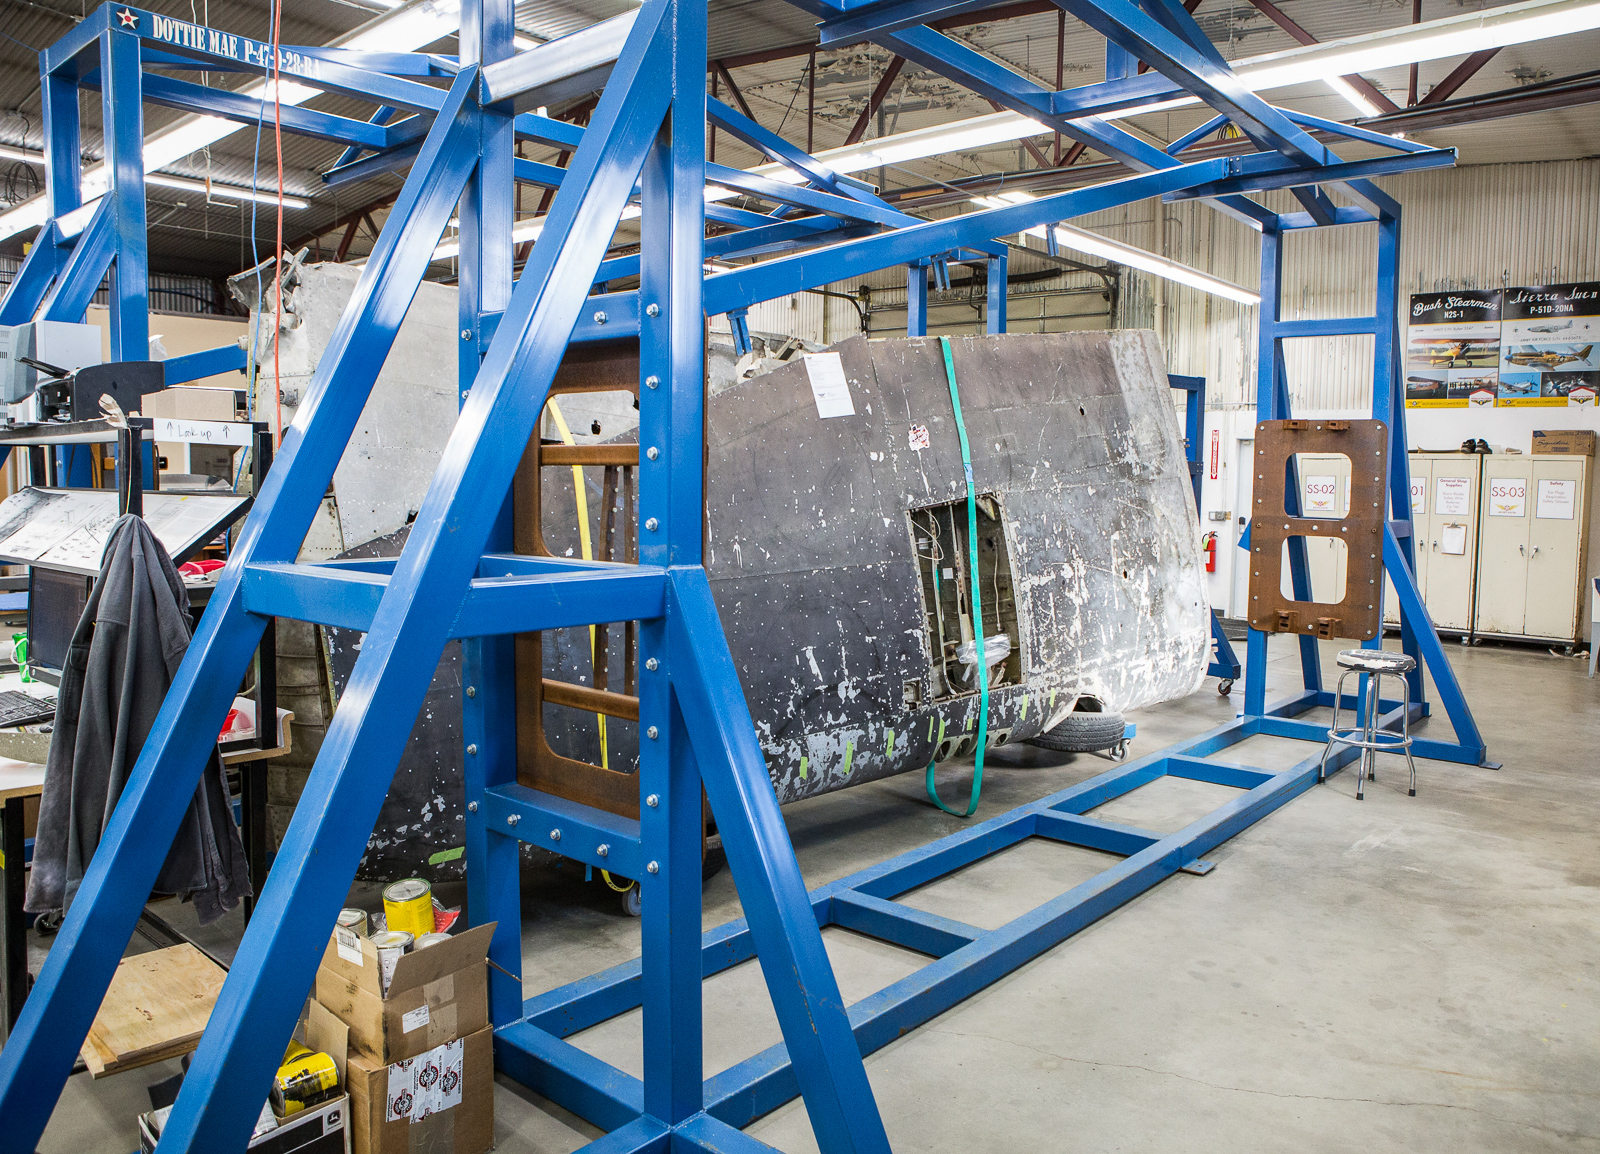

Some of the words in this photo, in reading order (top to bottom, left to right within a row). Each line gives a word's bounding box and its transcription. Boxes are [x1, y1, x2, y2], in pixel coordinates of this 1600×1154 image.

[152, 15, 205, 51] DOTTIE
[208, 30, 238, 59] MAE
[1509, 290, 1559, 304] Sierra
[1564, 287, 1590, 300] Sue
[1413, 299, 1443, 316] Bush
[1445, 296, 1499, 311] Stearman
[1530, 304, 1574, 314] P-51D-20NA
[1444, 310, 1464, 319] N2S-1
[178, 425, 198, 437] Look
[200, 430, 212, 441] up
[1307, 484, 1335, 495] SS-02
[1491, 486, 1525, 498] SS-03
